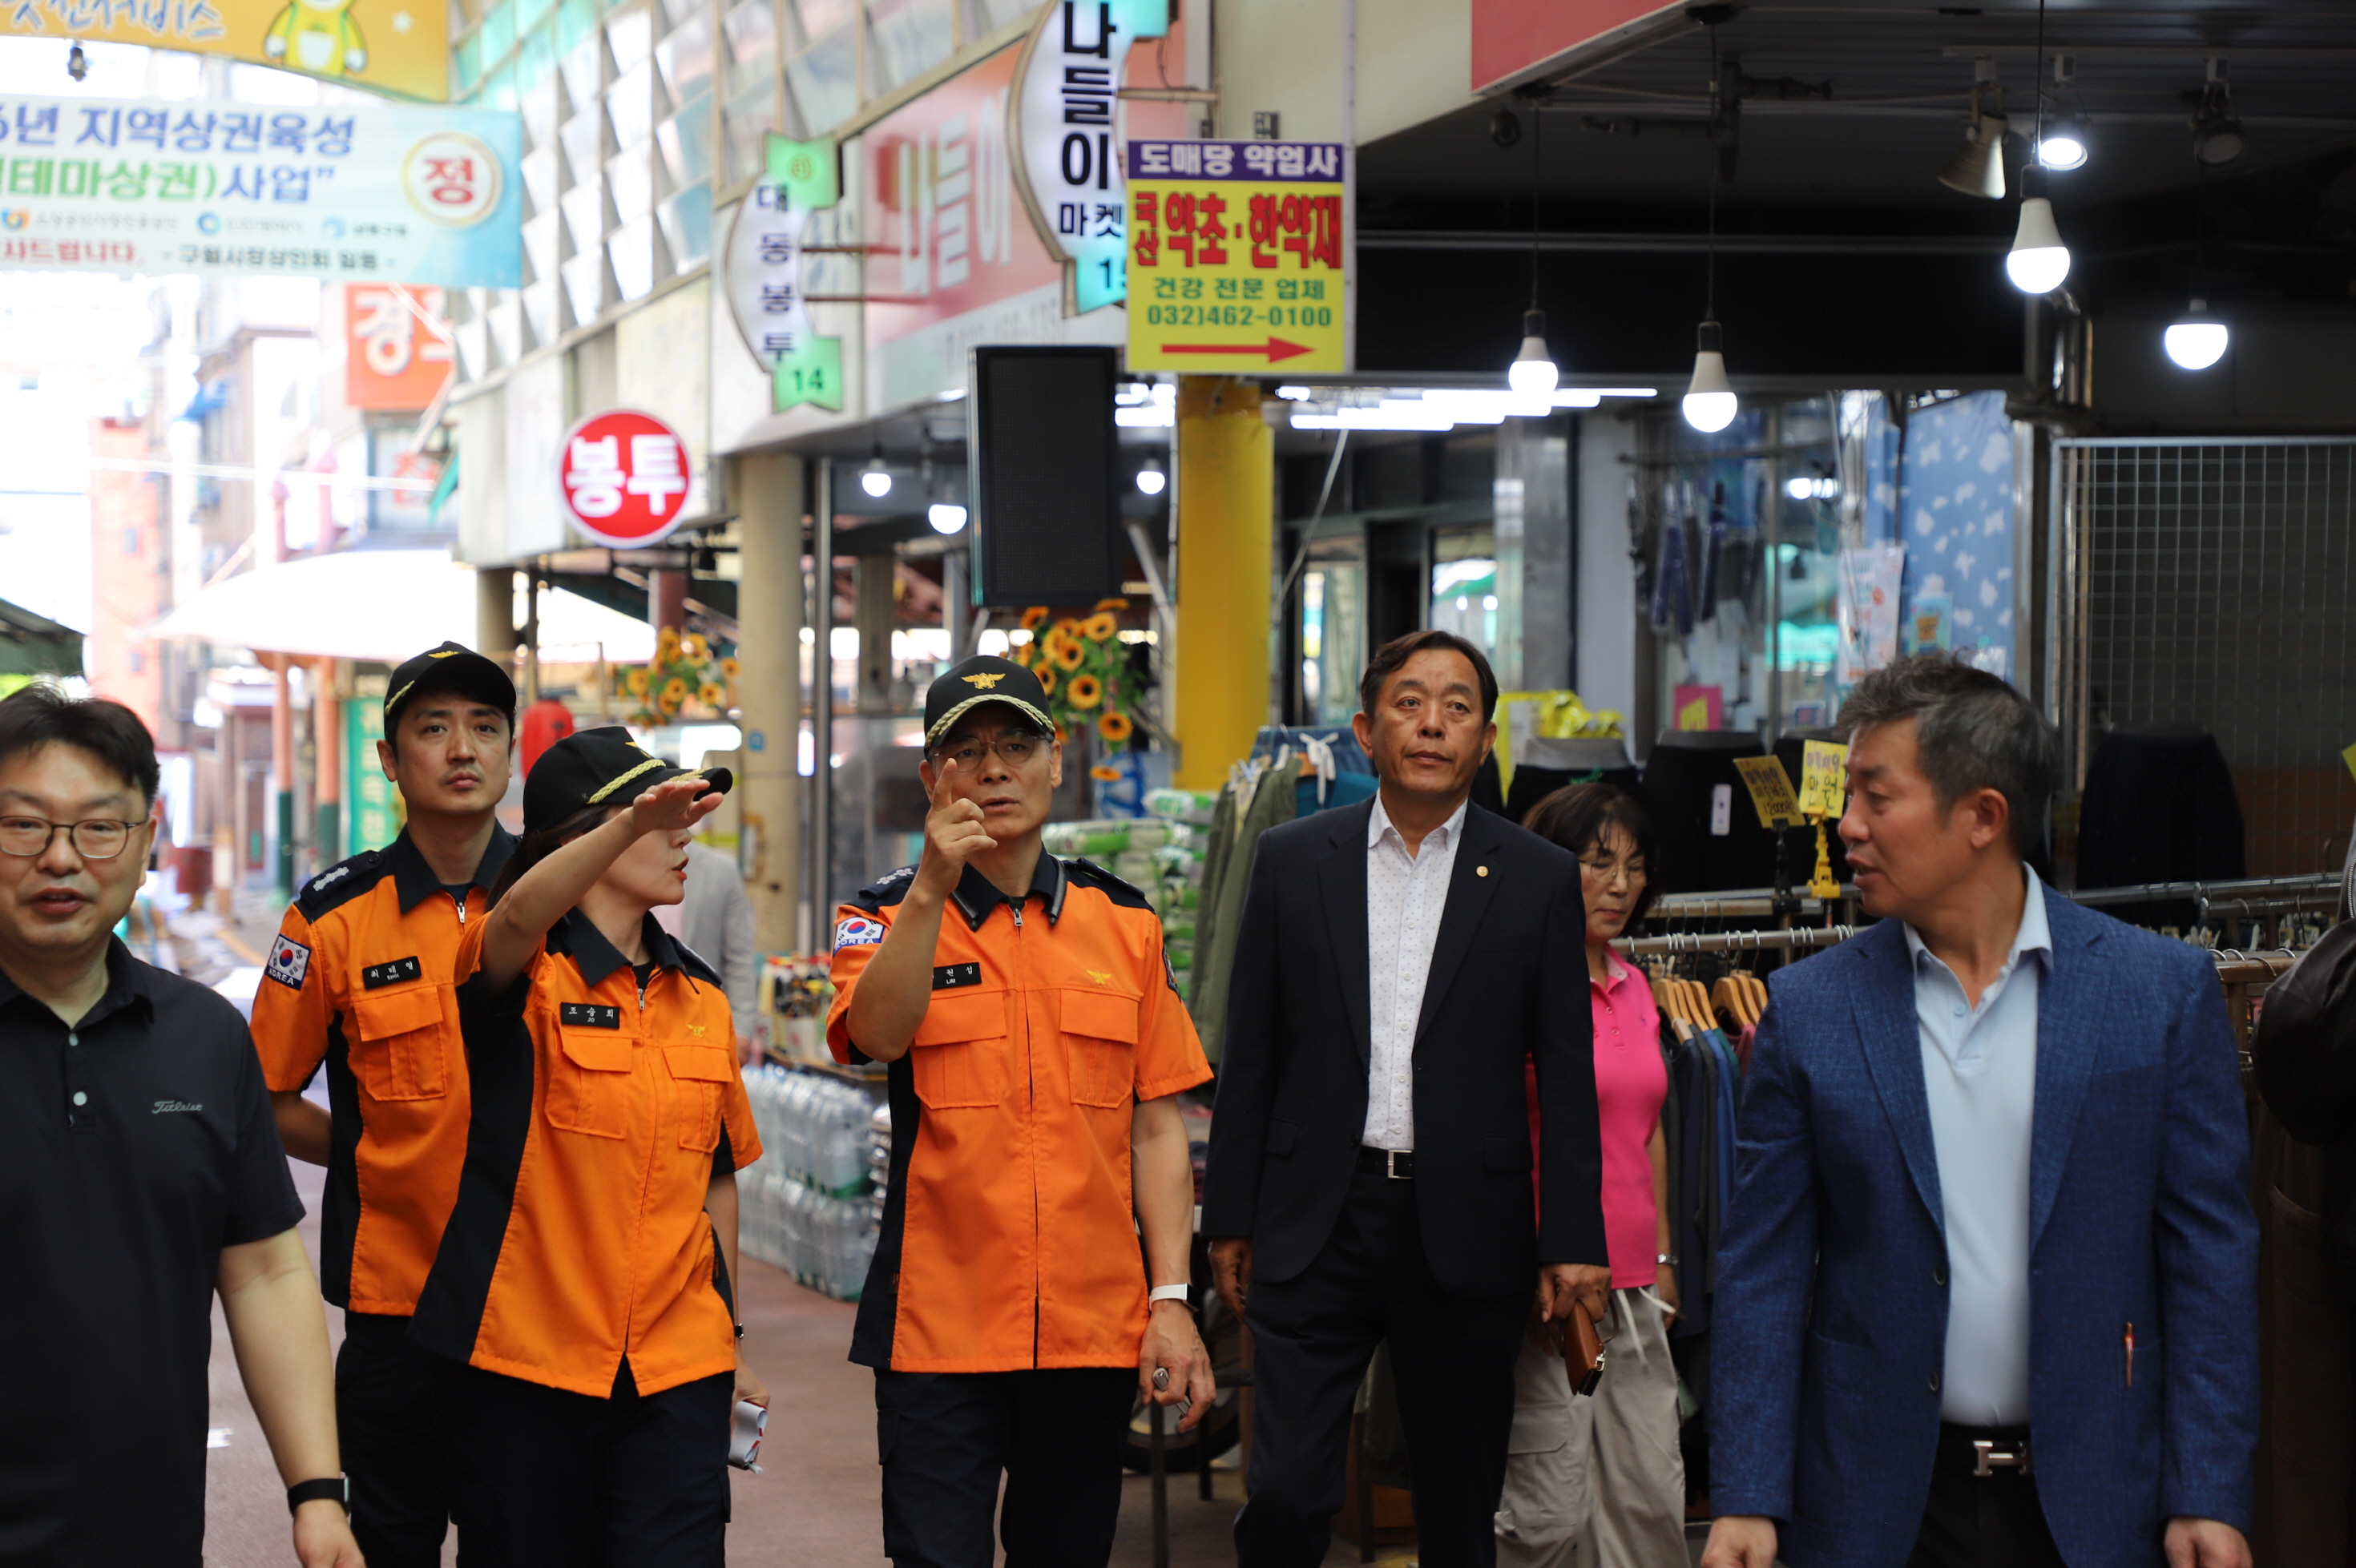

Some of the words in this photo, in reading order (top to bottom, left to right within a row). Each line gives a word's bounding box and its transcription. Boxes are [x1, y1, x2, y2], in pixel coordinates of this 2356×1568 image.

[1062, 0, 1117, 189] 나들이
[75, 107, 354, 156] 지역상권육성
[1140, 143, 1235, 176] 도매당
[1244, 144, 1338, 177] 약업사
[0, 158, 335, 201] 테마상권)사업”
[424, 157, 474, 204] 정
[899, 91, 1012, 298] 나들이
[1060, 204, 1122, 238] 마켓
[1134, 191, 1160, 267] 국산
[1099, 258, 1126, 292] 1
[1154, 277, 1204, 300] 건강
[1215, 277, 1264, 300] 전문
[1276, 278, 1326, 300] 업체
[1148, 304, 1332, 327] 032)462-0100
[793, 368, 824, 393] 14
[565, 434, 687, 518] 봉투
[268, 967, 295, 986] KOREA
[932, 965, 974, 979] 원섭
[151, 1100, 204, 1114] Titleist
